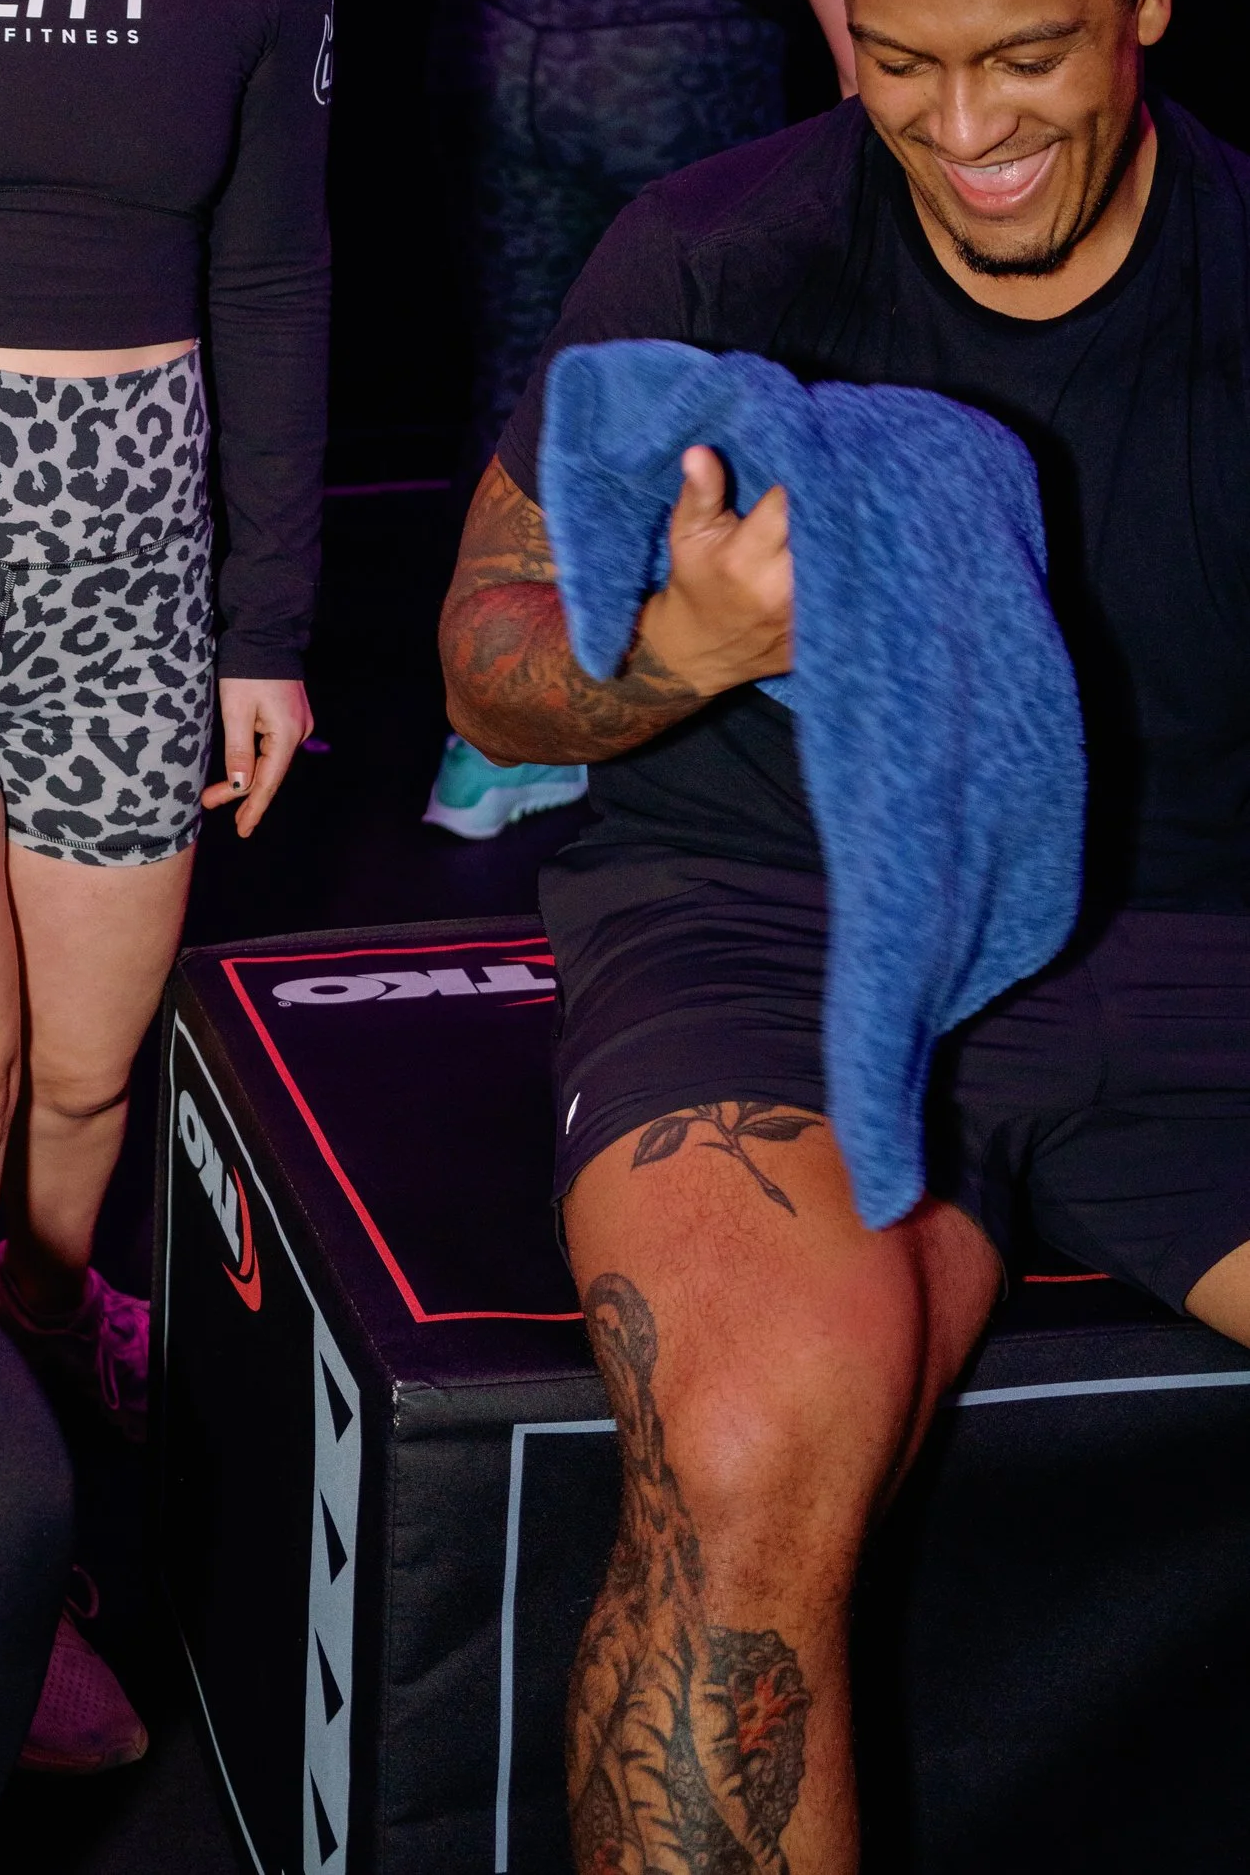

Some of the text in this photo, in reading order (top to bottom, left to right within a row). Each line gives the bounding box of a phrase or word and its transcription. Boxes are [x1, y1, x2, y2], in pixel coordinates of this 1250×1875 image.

[4, 28, 139, 44] FITNESS
[272, 964, 557, 1004] TKO
[179, 1090, 240, 1262] TKO
